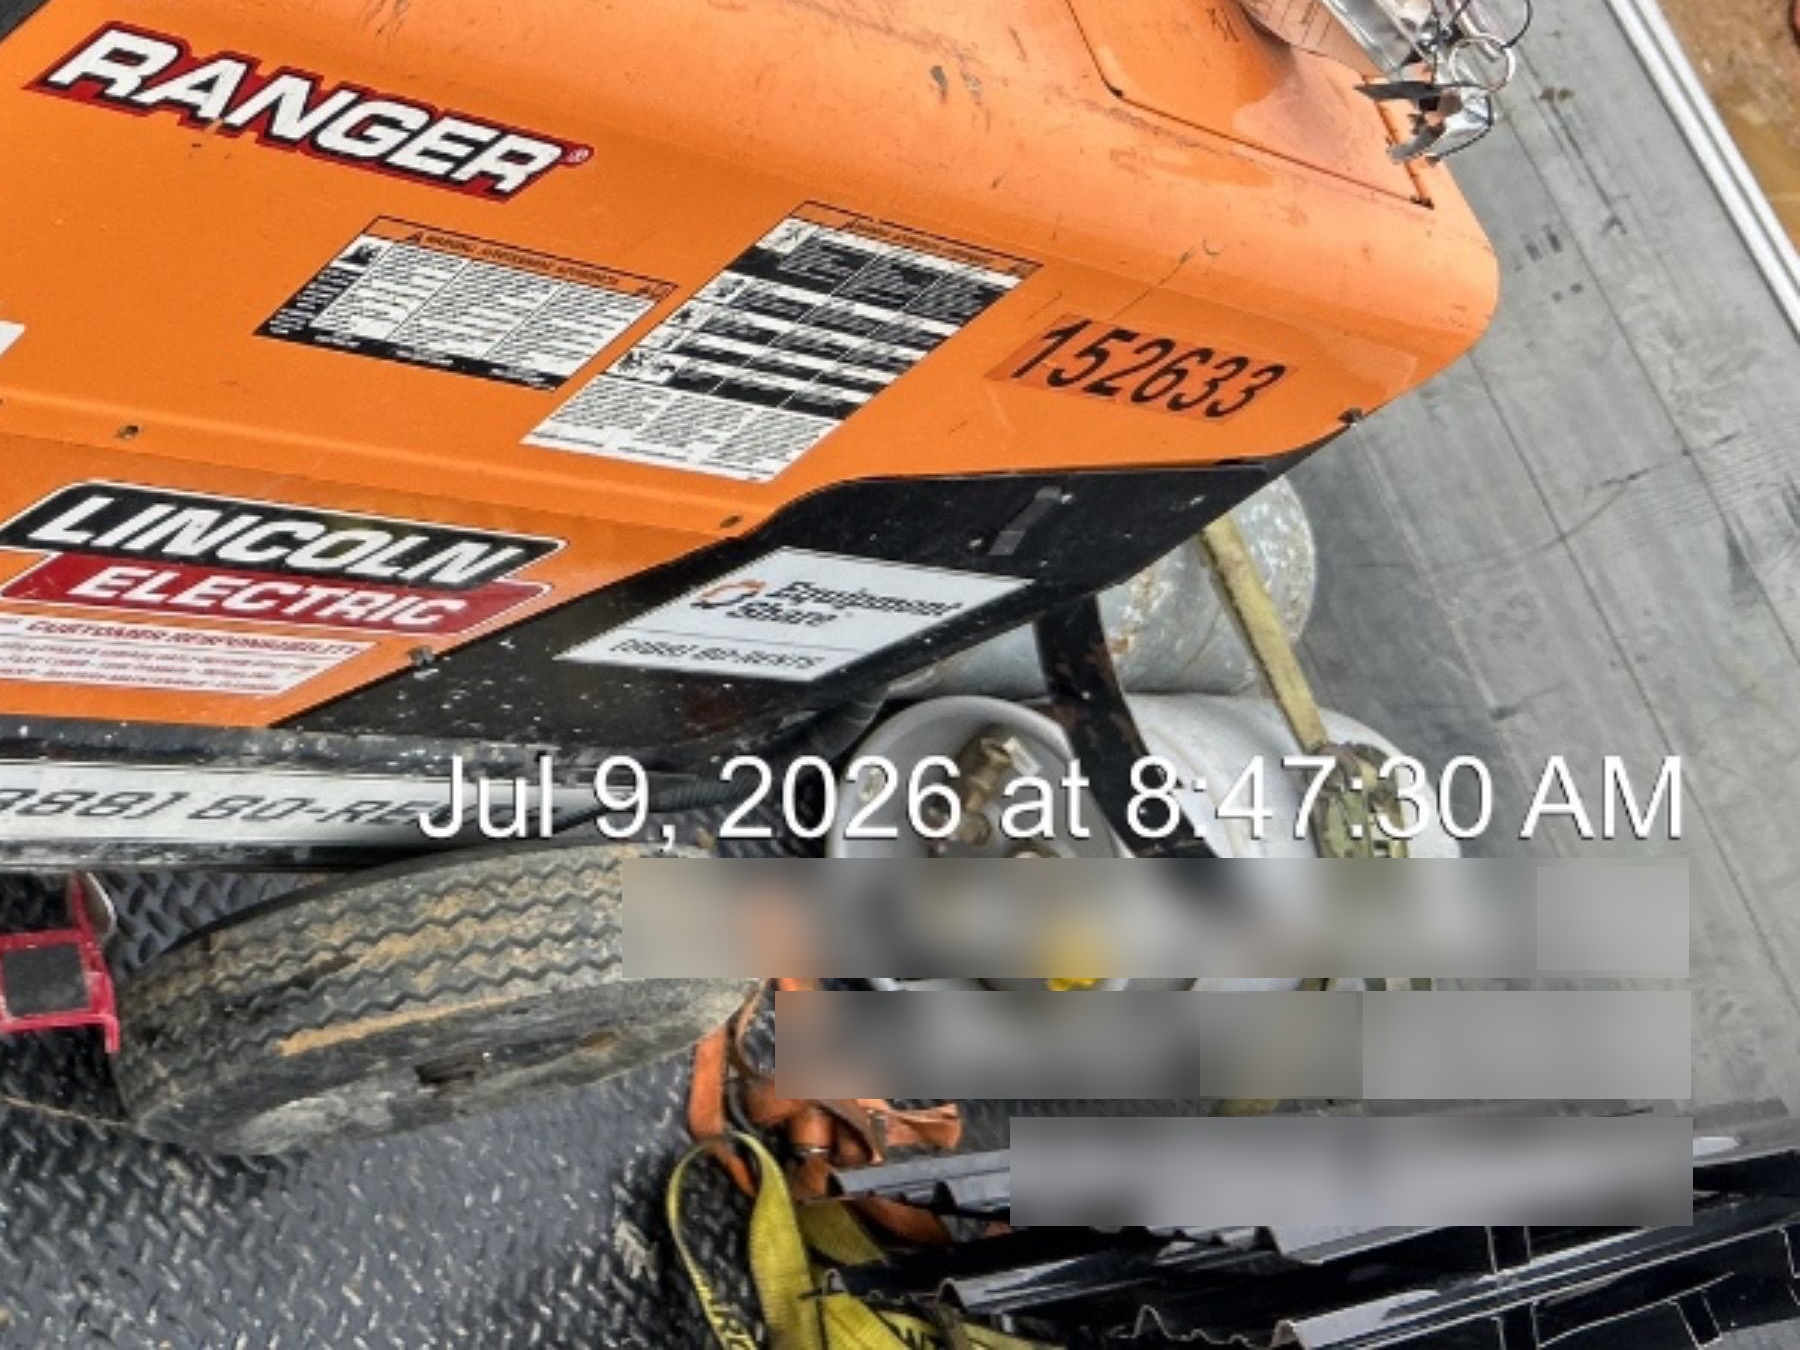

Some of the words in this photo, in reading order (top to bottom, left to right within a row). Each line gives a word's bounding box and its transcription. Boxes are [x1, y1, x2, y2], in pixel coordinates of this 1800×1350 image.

[47, 29, 562, 193] RANGER
[1012, 318, 1287, 417] 152633
[28, 497, 527, 586] LINCOLN
[68, 566, 466, 627] ELECTRIC
[725, 599, 838, 628] Share
[766, 581, 963, 618] Equipment
